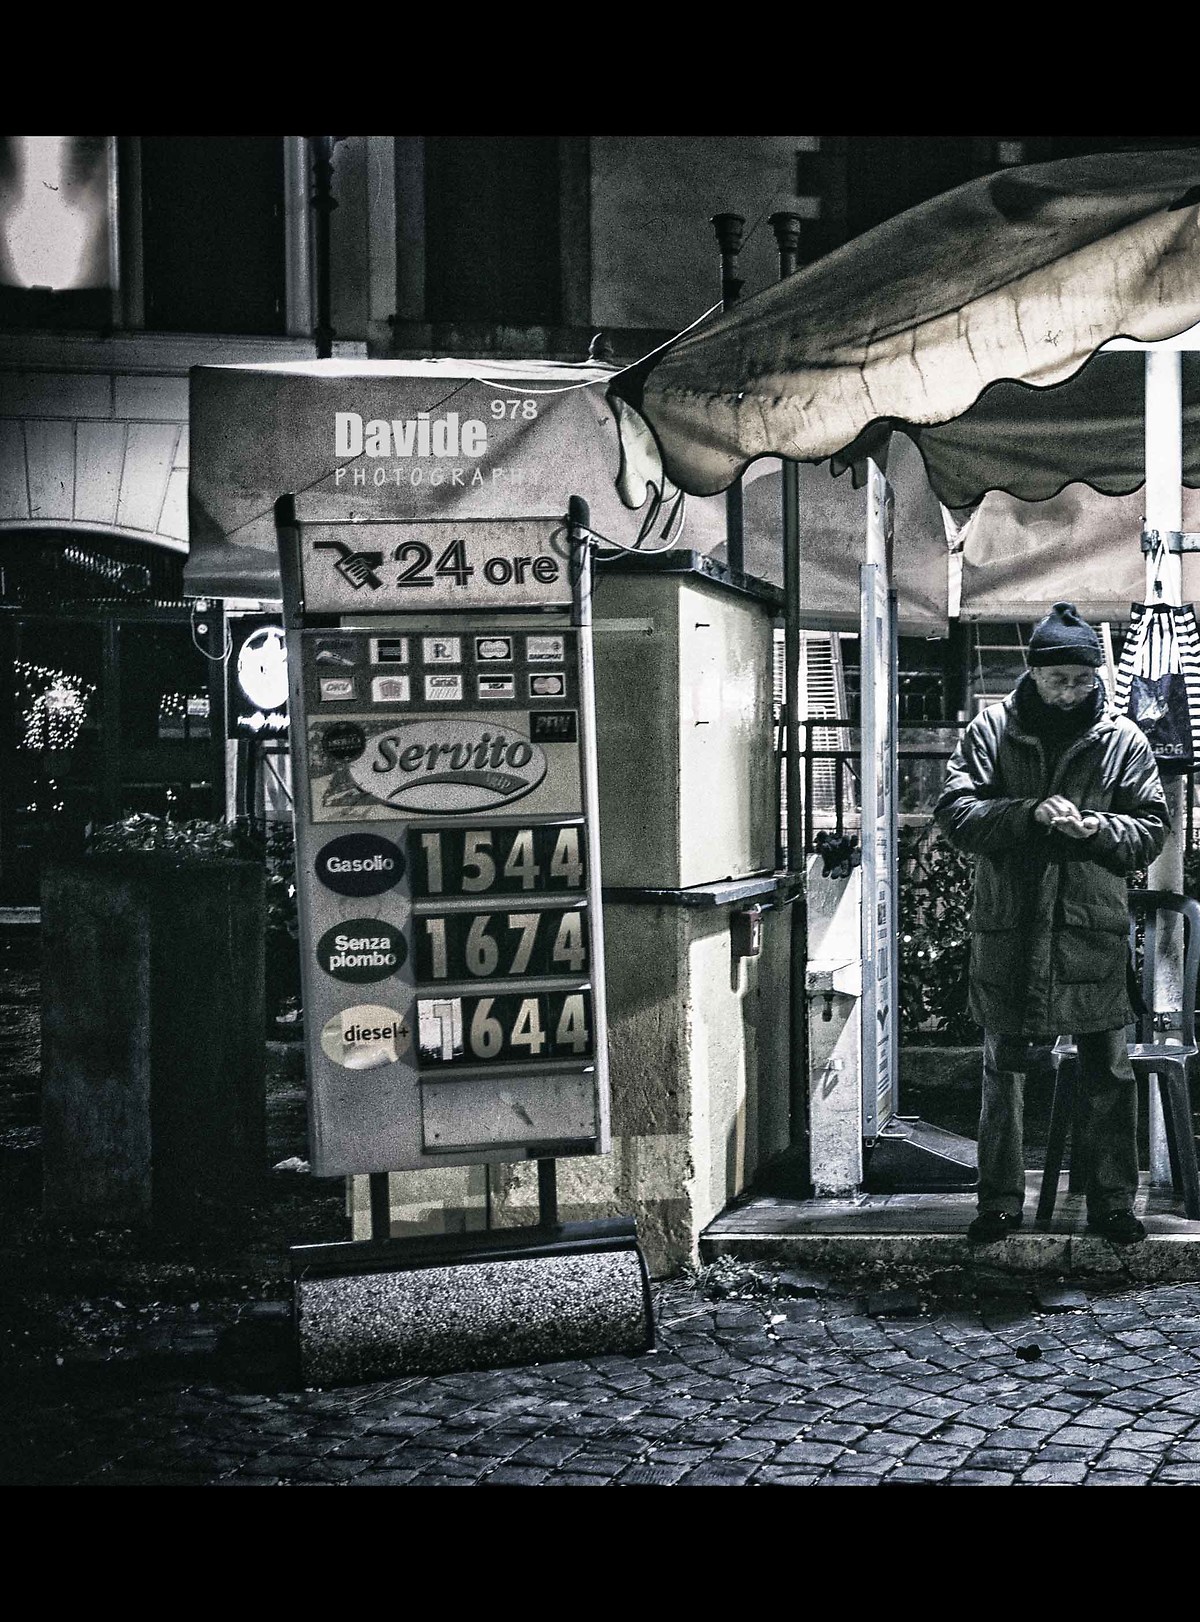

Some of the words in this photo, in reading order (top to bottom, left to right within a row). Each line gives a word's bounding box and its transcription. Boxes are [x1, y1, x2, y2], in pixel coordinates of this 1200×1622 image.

[390, 540, 474, 587] 24
[484, 555, 559, 585] ore
[372, 732, 533, 772] Servito
[326, 855, 395, 875] Gasolio
[420, 827, 583, 893] 1544
[329, 950, 397, 972] piombo
[334, 935, 391, 951] Senza
[425, 911, 586, 979] 1674
[344, 1022, 409, 1042] diesel+
[433, 994, 589, 1060] 1644
